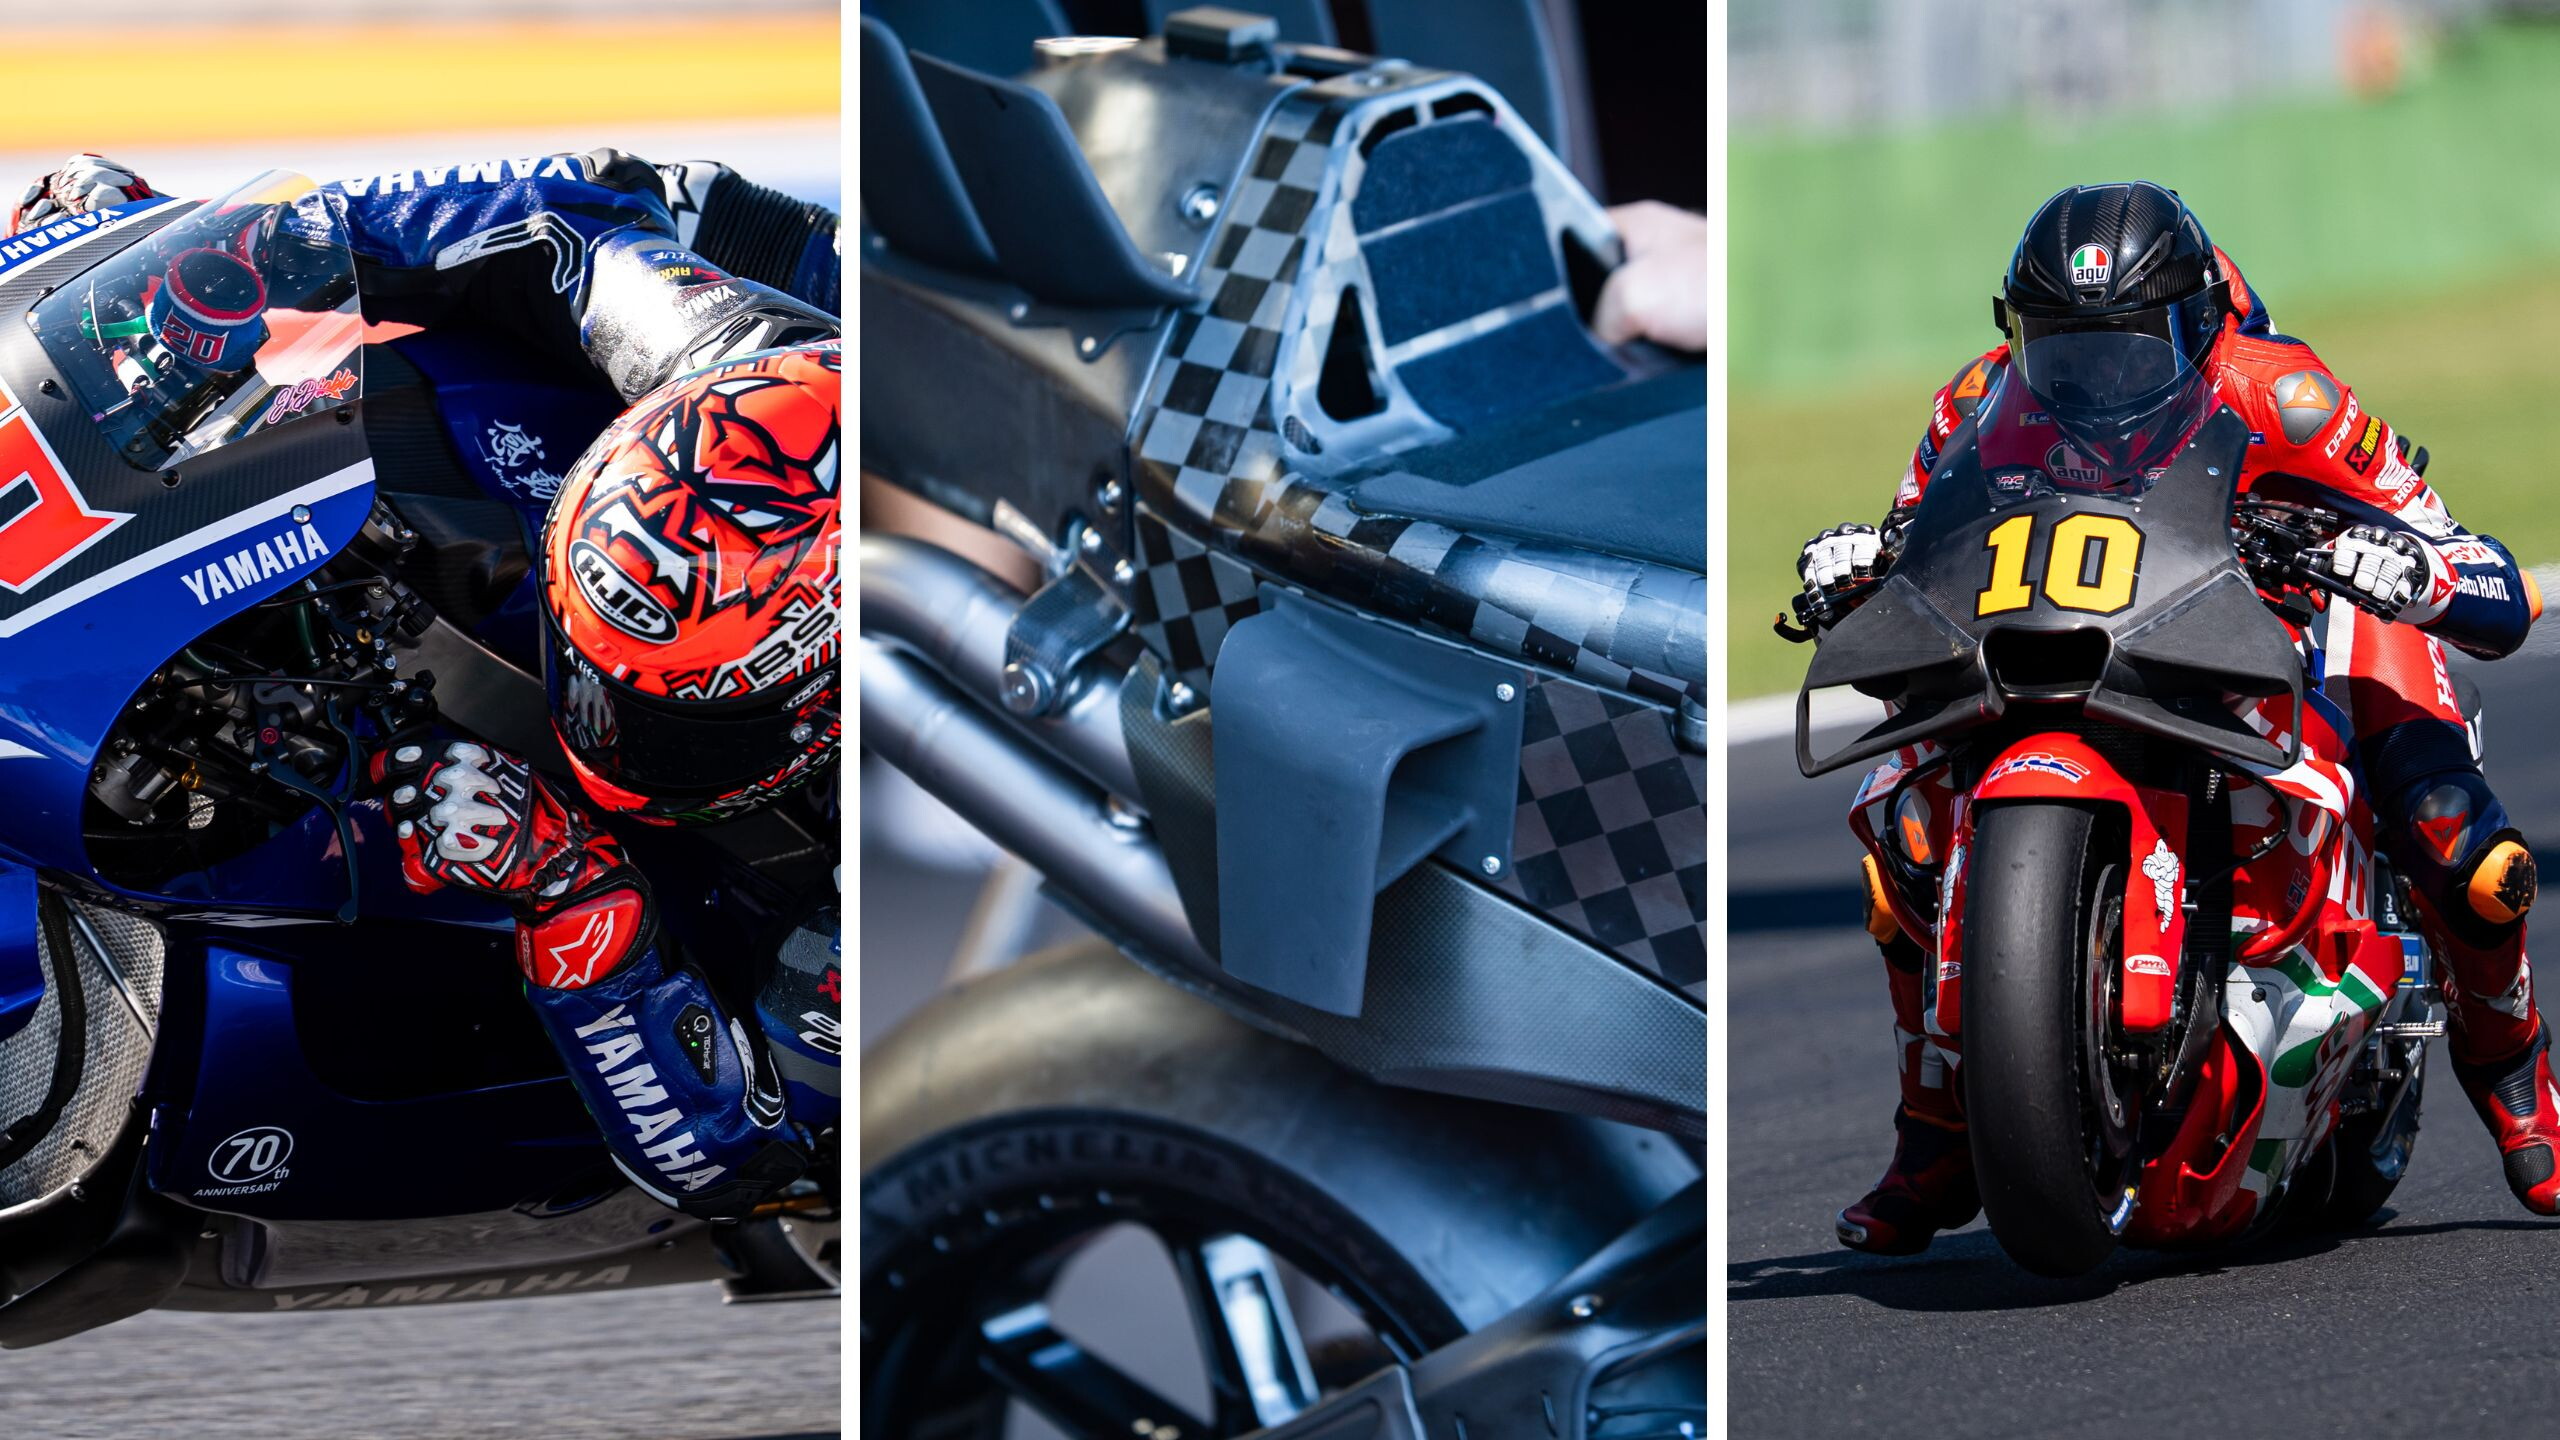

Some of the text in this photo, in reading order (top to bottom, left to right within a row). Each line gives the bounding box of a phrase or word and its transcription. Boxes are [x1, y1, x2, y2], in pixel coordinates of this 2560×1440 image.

[340, 157, 576, 197] YAMAHA
[0, 207, 124, 267] YAMAH
[2076, 267, 2106, 283] agv
[160, 306, 229, 364] 20
[291, 368, 358, 412] Diablo
[181, 523, 330, 606] YAMAHA
[578, 555, 663, 630] HJC
[1975, 512, 2145, 621] 10
[574, 1003, 728, 1192] YAMAHA
[193, 1181, 281, 1198] ANNIVERSARY
[901, 1131, 1223, 1206] MICHELIN
[273, 1264, 632, 1311] YAMAHA
